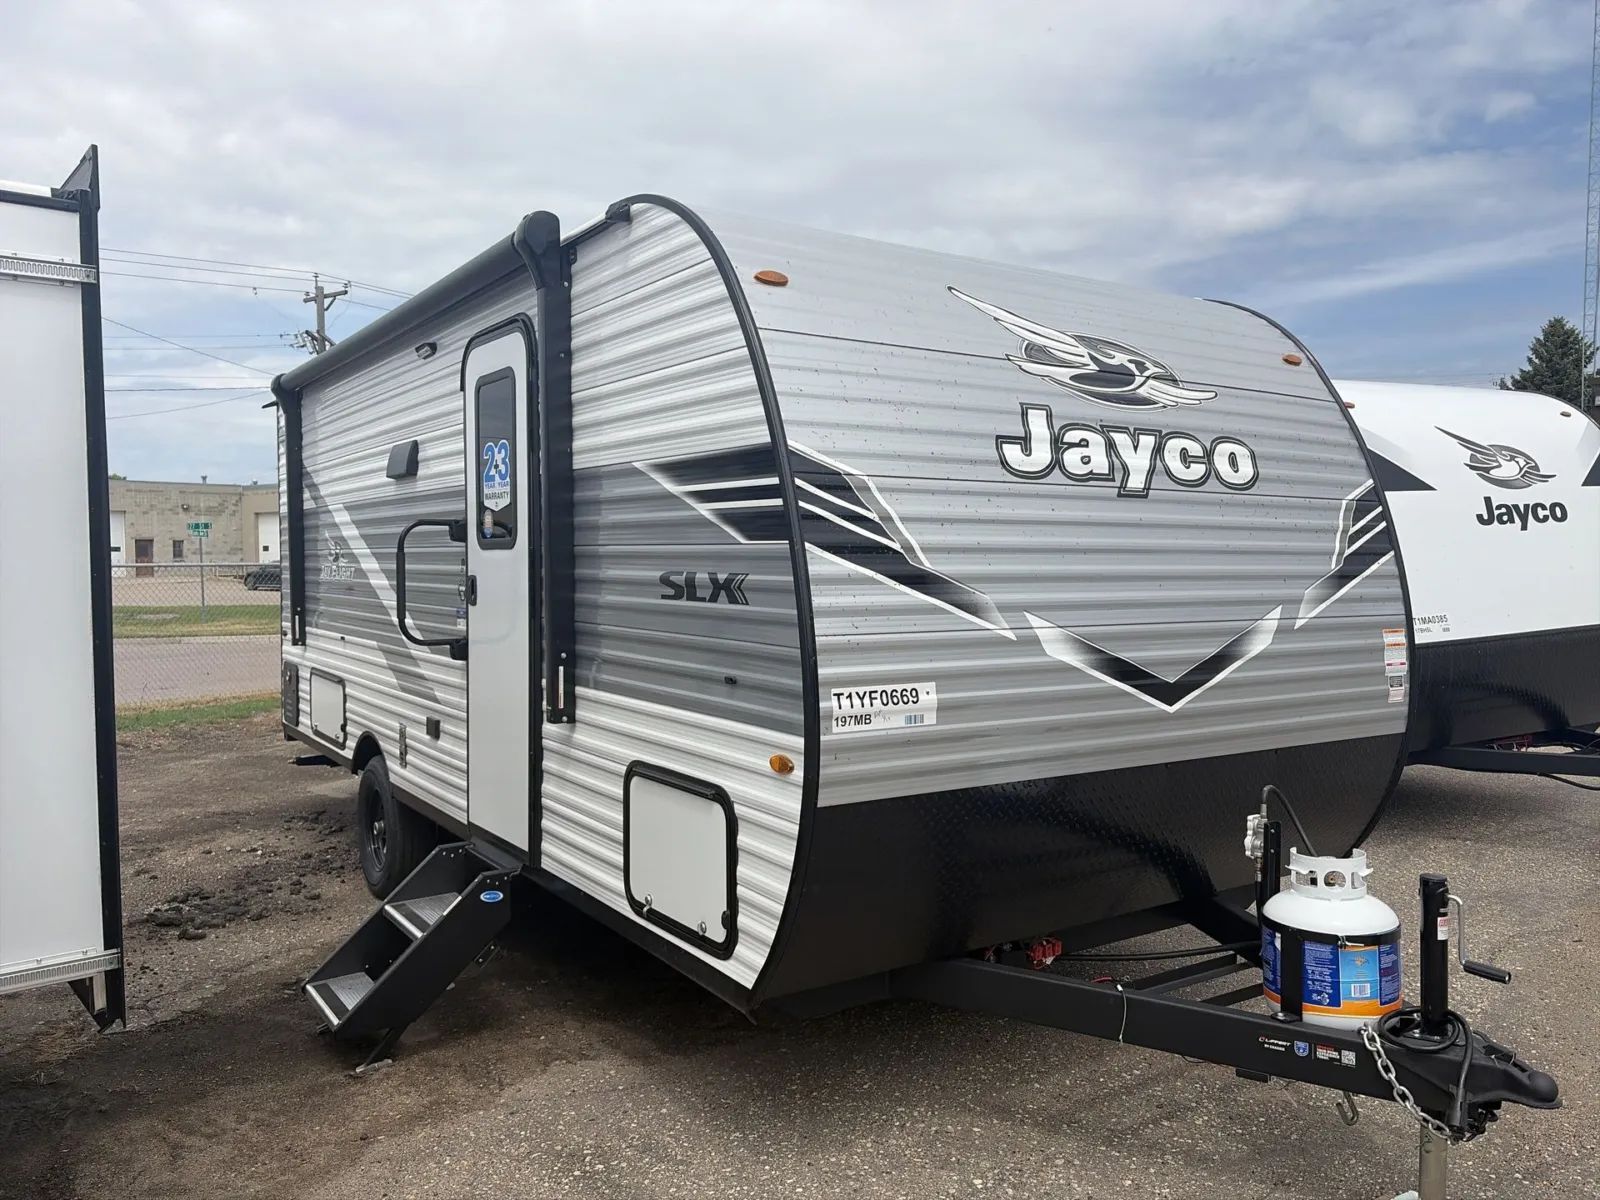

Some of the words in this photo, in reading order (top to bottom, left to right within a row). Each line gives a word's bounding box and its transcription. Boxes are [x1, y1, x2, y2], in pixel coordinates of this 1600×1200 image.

[995, 402, 1259, 498] Jayco
[484, 491, 509, 501] WARRANTY
[497, 481, 509, 489] YEAR
[1476, 496, 1568, 532] Jayco
[659, 570, 750, 605] SLX
[833, 687, 920, 710] T1YF0669
[833, 713, 872, 727] 197MB
